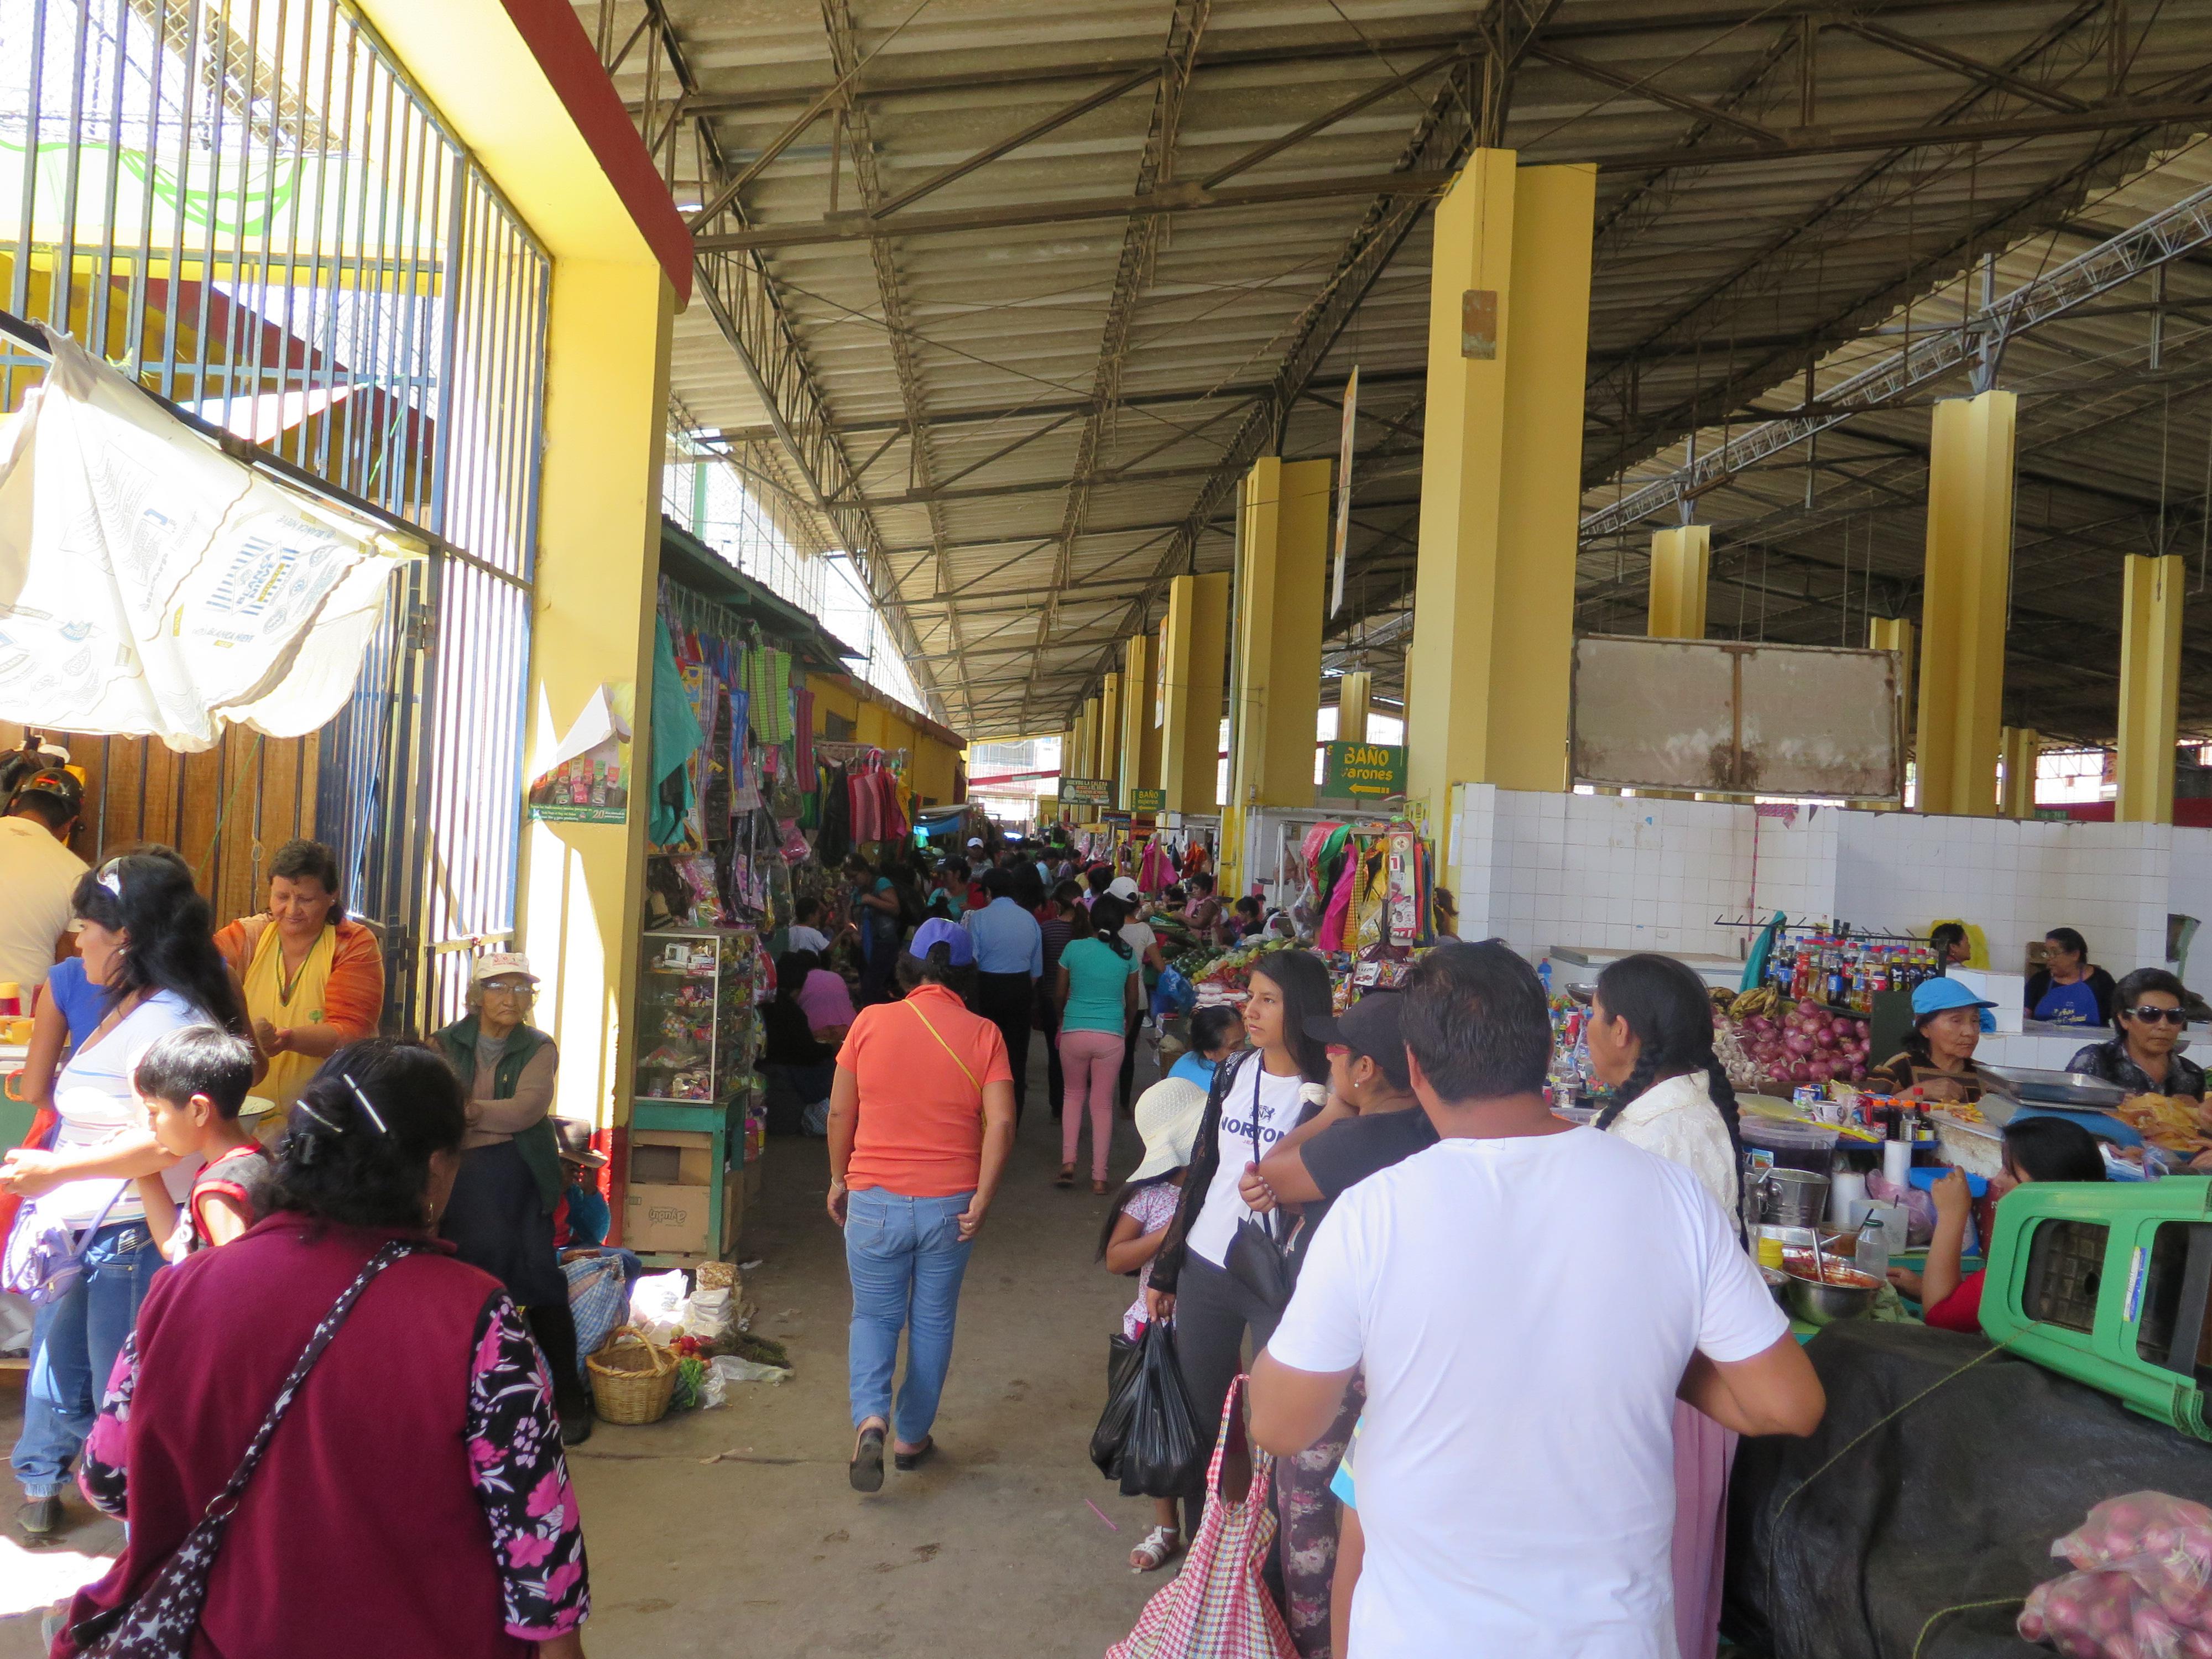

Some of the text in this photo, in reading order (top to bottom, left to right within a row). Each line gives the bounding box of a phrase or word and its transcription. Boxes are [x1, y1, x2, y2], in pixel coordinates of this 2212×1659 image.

[236, 552, 274, 605] BLANCA
[248, 561, 275, 599] NIEVE
[1344, 745, 1389, 766] BAÑO
[1139, 790, 1159, 799] BAÑO
[1243, 1139, 1261, 1147] JEAS
